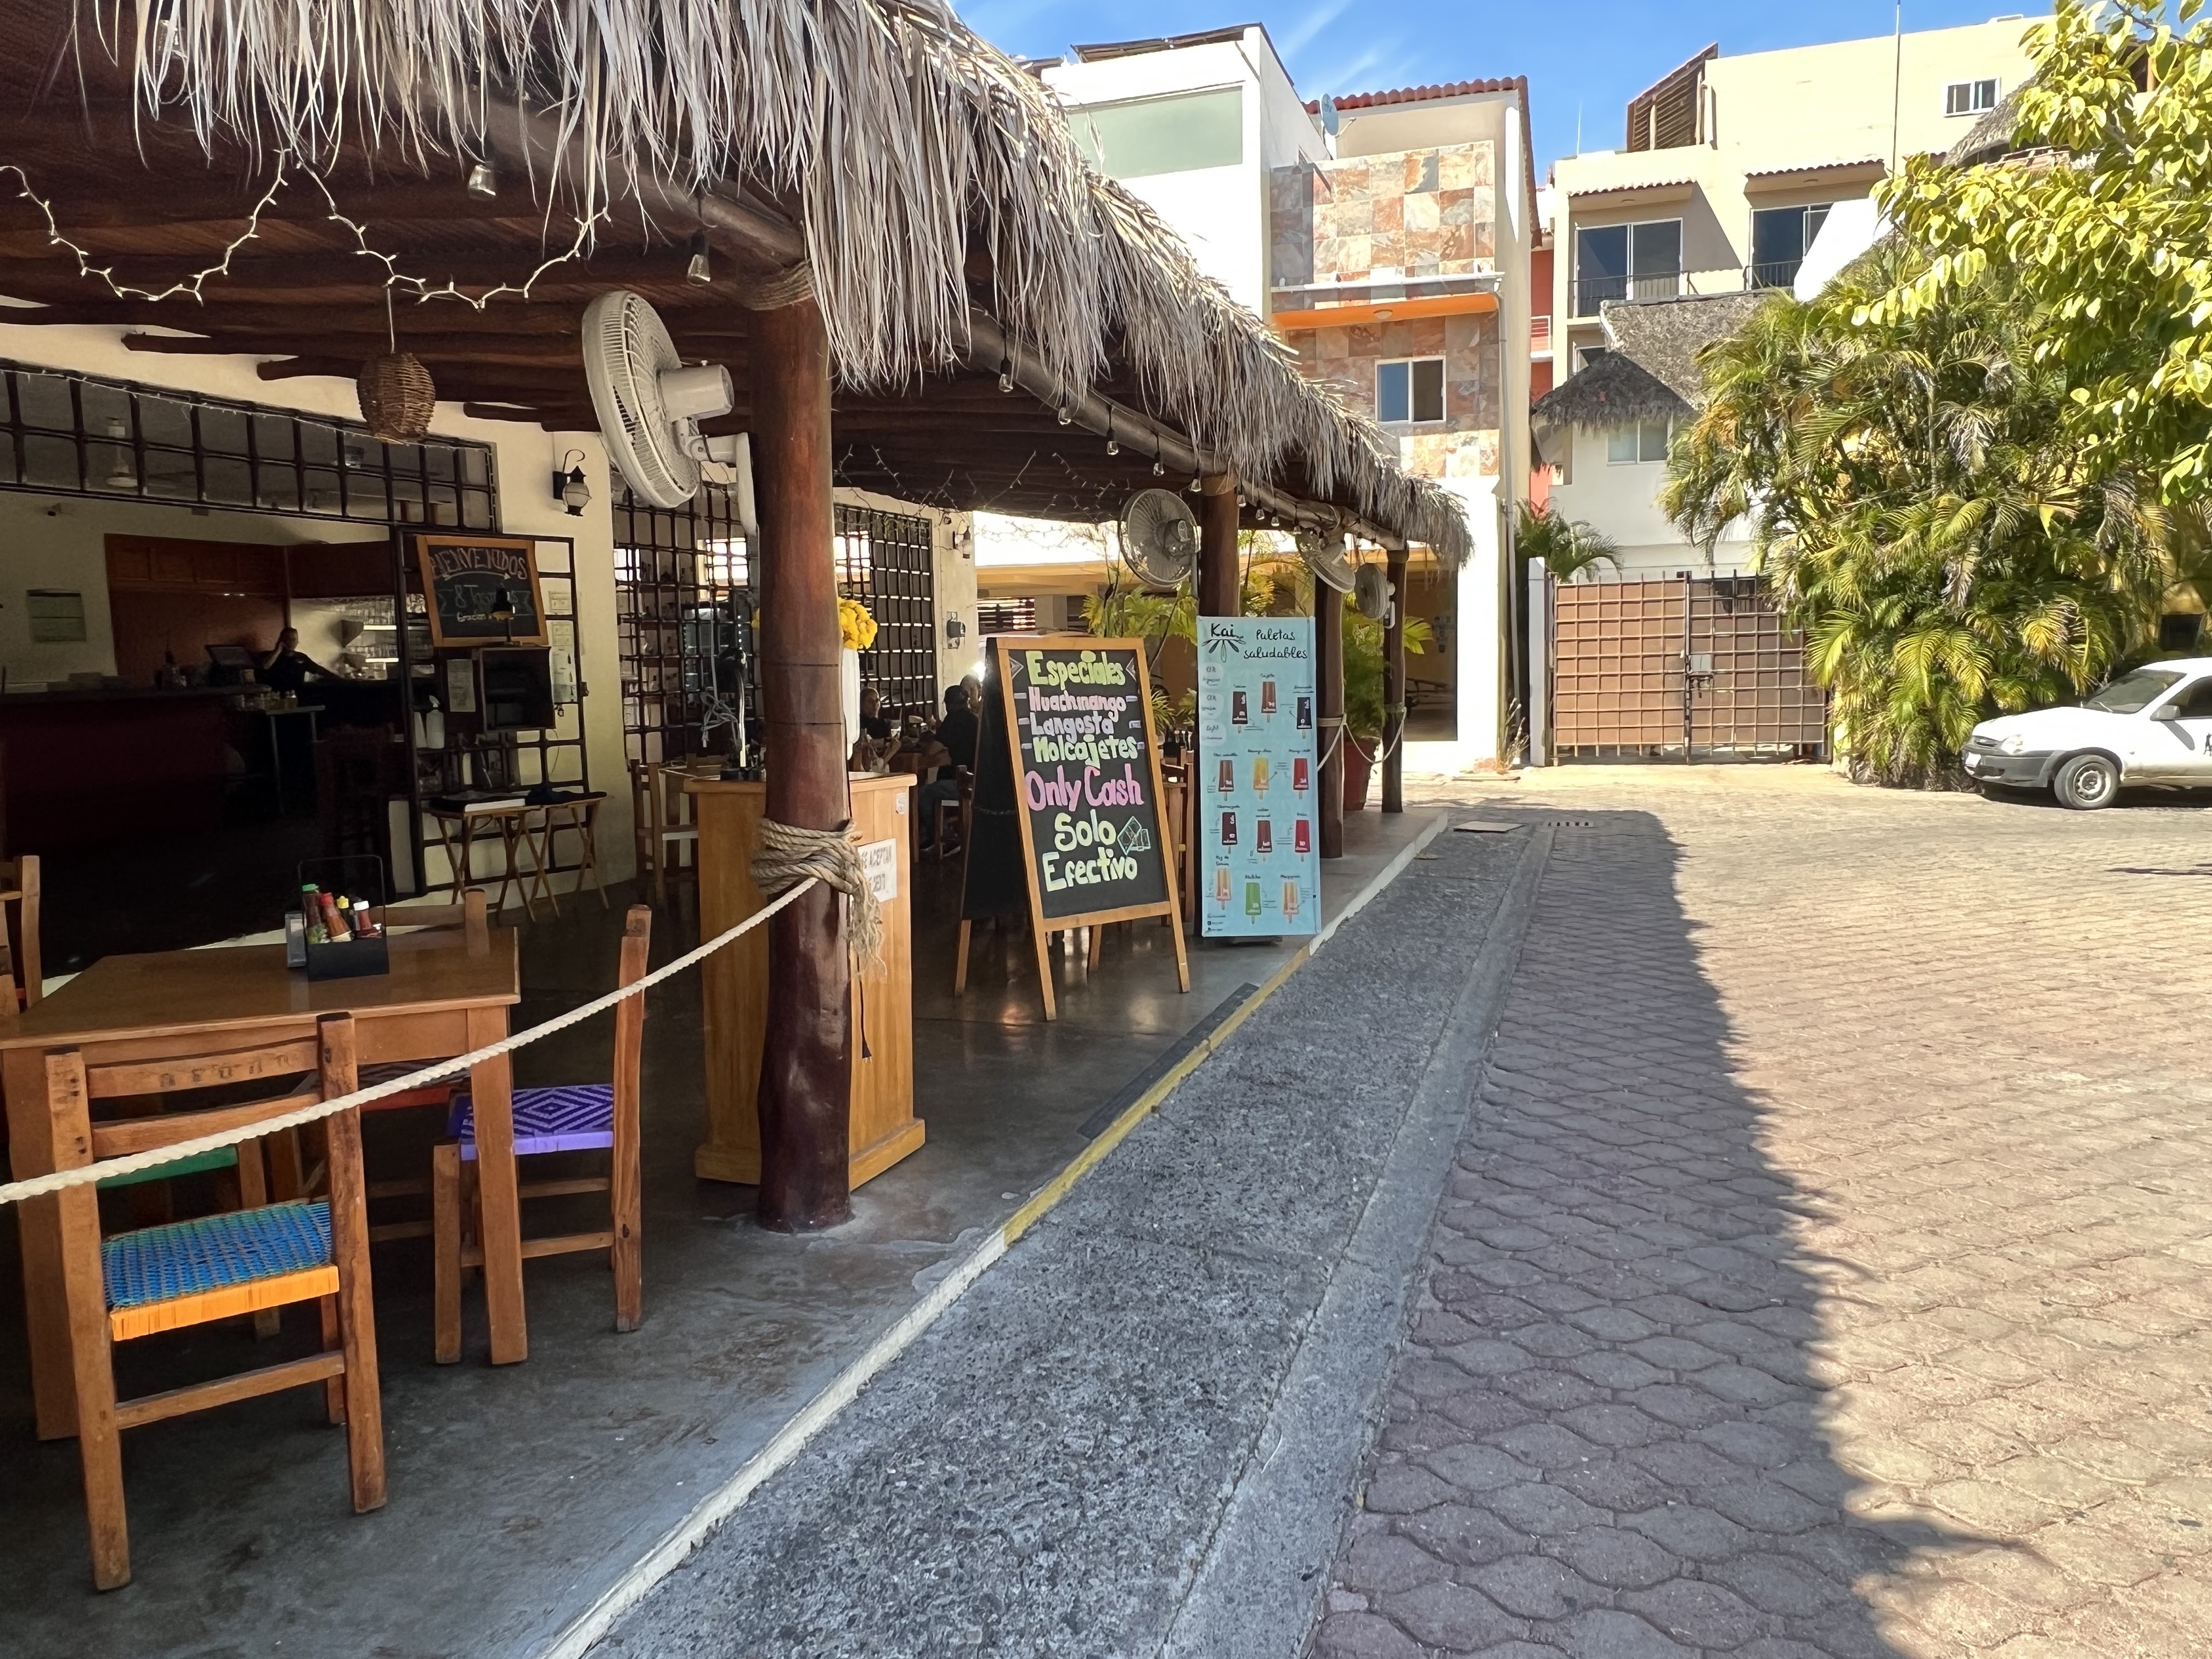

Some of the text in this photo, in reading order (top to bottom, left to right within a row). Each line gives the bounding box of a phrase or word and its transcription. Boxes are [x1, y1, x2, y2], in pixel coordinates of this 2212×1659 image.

[429, 548, 527, 580] BIENVENIDOS
[1211, 623, 1234, 637] Kai
[1256, 628, 1295, 641] Paletas
[1244, 647, 1308, 659] saludables
[1026, 651, 1126, 690] Especiales
[1030, 710, 1115, 744] Langosta
[1033, 734, 1138, 769] Molcajetes
[1024, 763, 1144, 811] Only Cash
[1054, 809, 1116, 851] Solo
[1042, 847, 1138, 891] Efectivo
